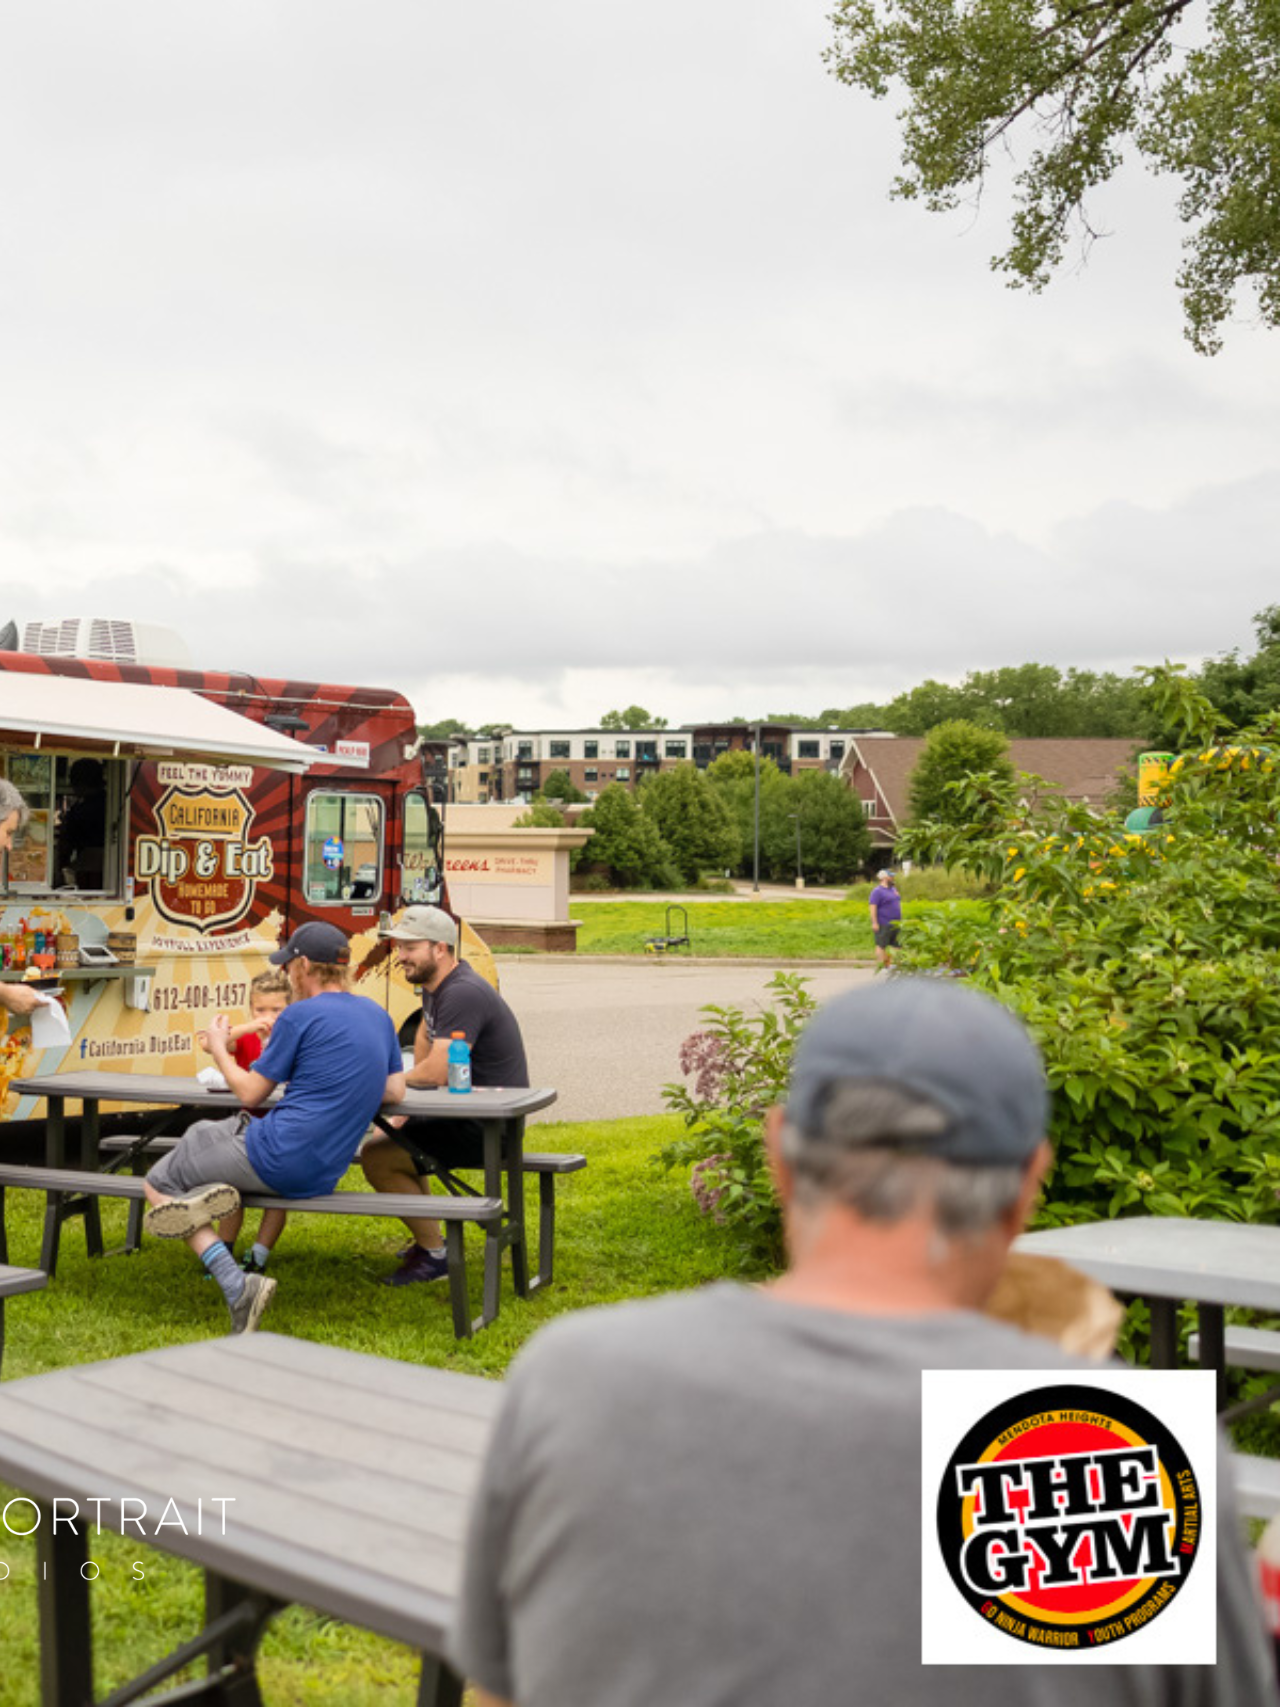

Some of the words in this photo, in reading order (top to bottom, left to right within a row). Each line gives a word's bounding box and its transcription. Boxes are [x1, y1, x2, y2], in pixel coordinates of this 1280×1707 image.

[160, 765, 185, 780] FEEL
[188, 767, 208, 781] THE
[211, 769, 251, 783] YUMMY
[139, 840, 187, 883] Dip
[196, 841, 218, 877] &
[225, 841, 270, 877] Eat
[178, 881, 230, 898] HOMEMADE
[190, 900, 202, 915] TO
[204, 900, 217, 915] GO
